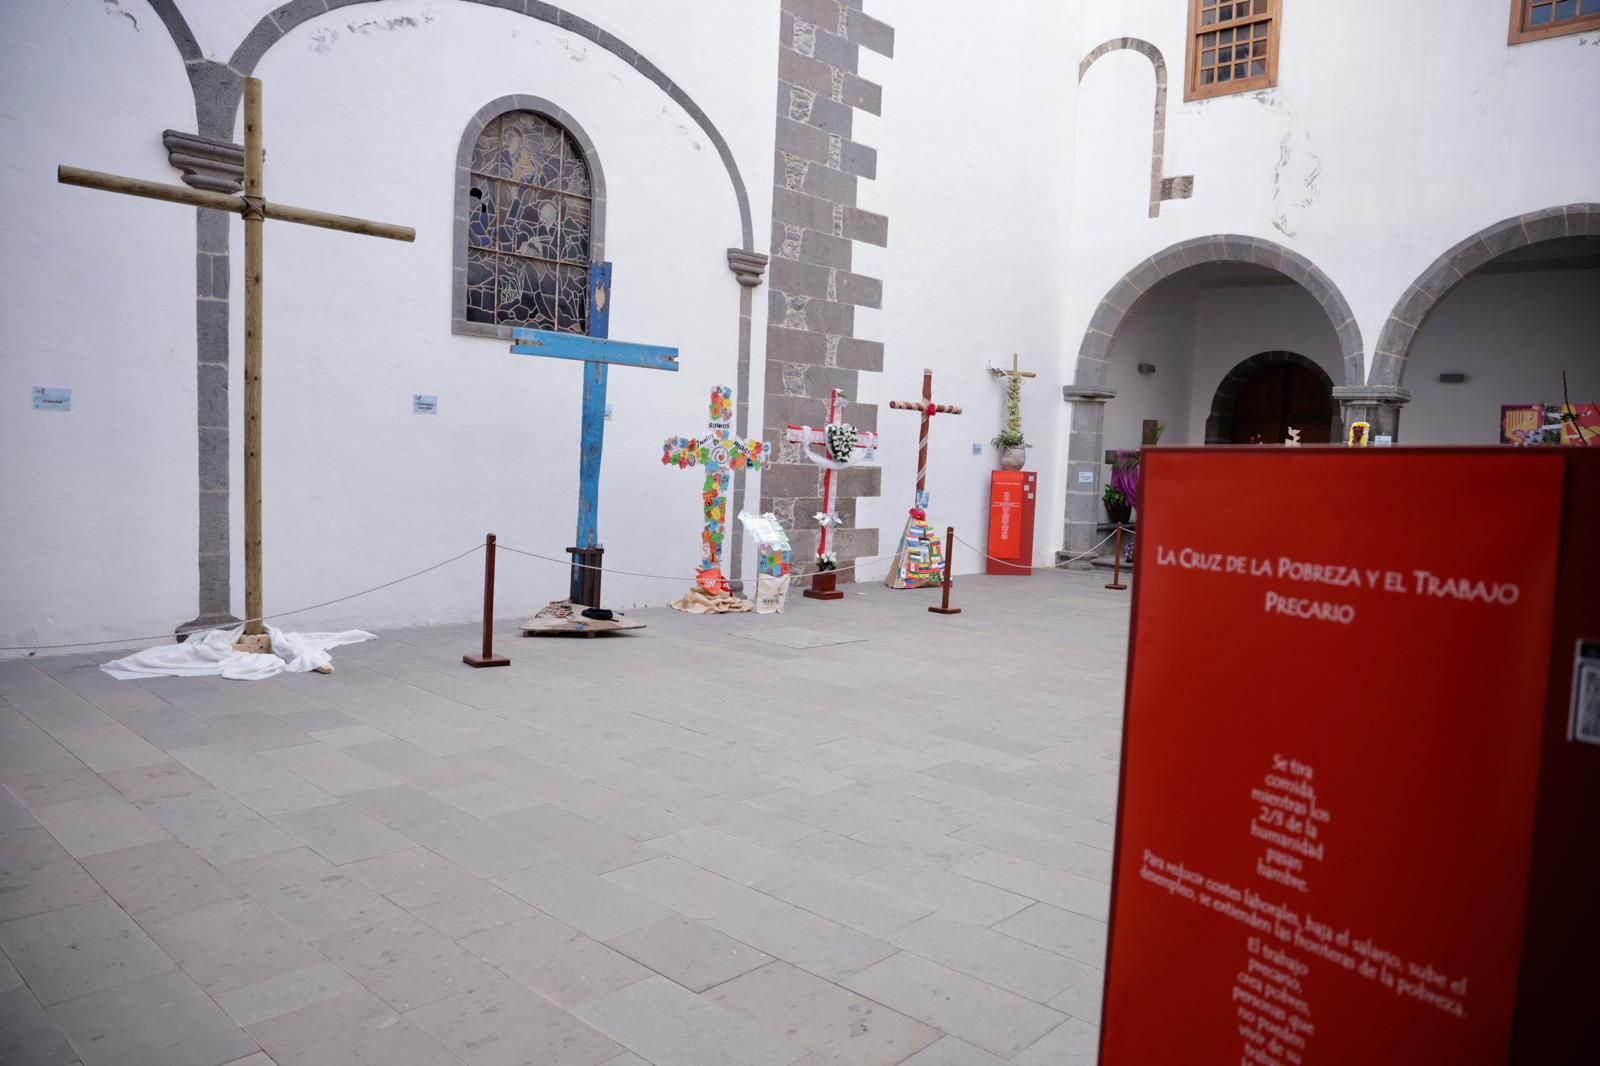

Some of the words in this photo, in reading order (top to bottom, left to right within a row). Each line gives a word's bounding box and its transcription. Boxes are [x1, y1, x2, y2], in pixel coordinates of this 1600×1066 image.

[1157, 545, 1176, 565] LA
[1179, 548, 1222, 572] CRUZ
[1225, 556, 1247, 574] DE
[1251, 558, 1273, 576] LA
[1278, 557, 1361, 587] POBREZA
[1366, 570, 1380, 589] Y
[1384, 571, 1407, 593] EL
[1413, 570, 1520, 605] TRABAJO
[1264, 591, 1355, 624] PRECARIO
[1272, 753, 1288, 771] Se
[1290, 759, 1313, 780] tira
[1251, 787, 1307, 816] mientras
[1310, 798, 1330, 823] los
[1264, 774, 1316, 802] comida,
[1250, 818, 1324, 862] humanidad
[1259, 805, 1284, 826] 2/3
[1285, 815, 1303, 834] de
[1304, 818, 1317, 840] la
[1256, 856, 1309, 893] hambre.
[1266, 848, 1303, 872] pasan
[1143, 848, 1165, 870] Para
[1166, 861, 1204, 886] reducir
[1305, 913, 1334, 944] baja
[1335, 928, 1350, 948] el
[1352, 938, 1404, 973] salario,
[1408, 962, 1448, 989] sube
[1450, 977, 1468, 996] el
[1198, 892, 1212, 908] se
[1273, 915, 1292, 942] las
[1293, 928, 1356, 970] fronteras
[1357, 960, 1378, 980] de
[1380, 965, 1394, 989] la
[1396, 977, 1467, 1018] pobreza.
[1247, 936, 1261, 954] El
[1262, 944, 1309, 977] trabajo
[1237, 1006, 1256, 1023] no
[1288, 1015, 1315, 1036] que
